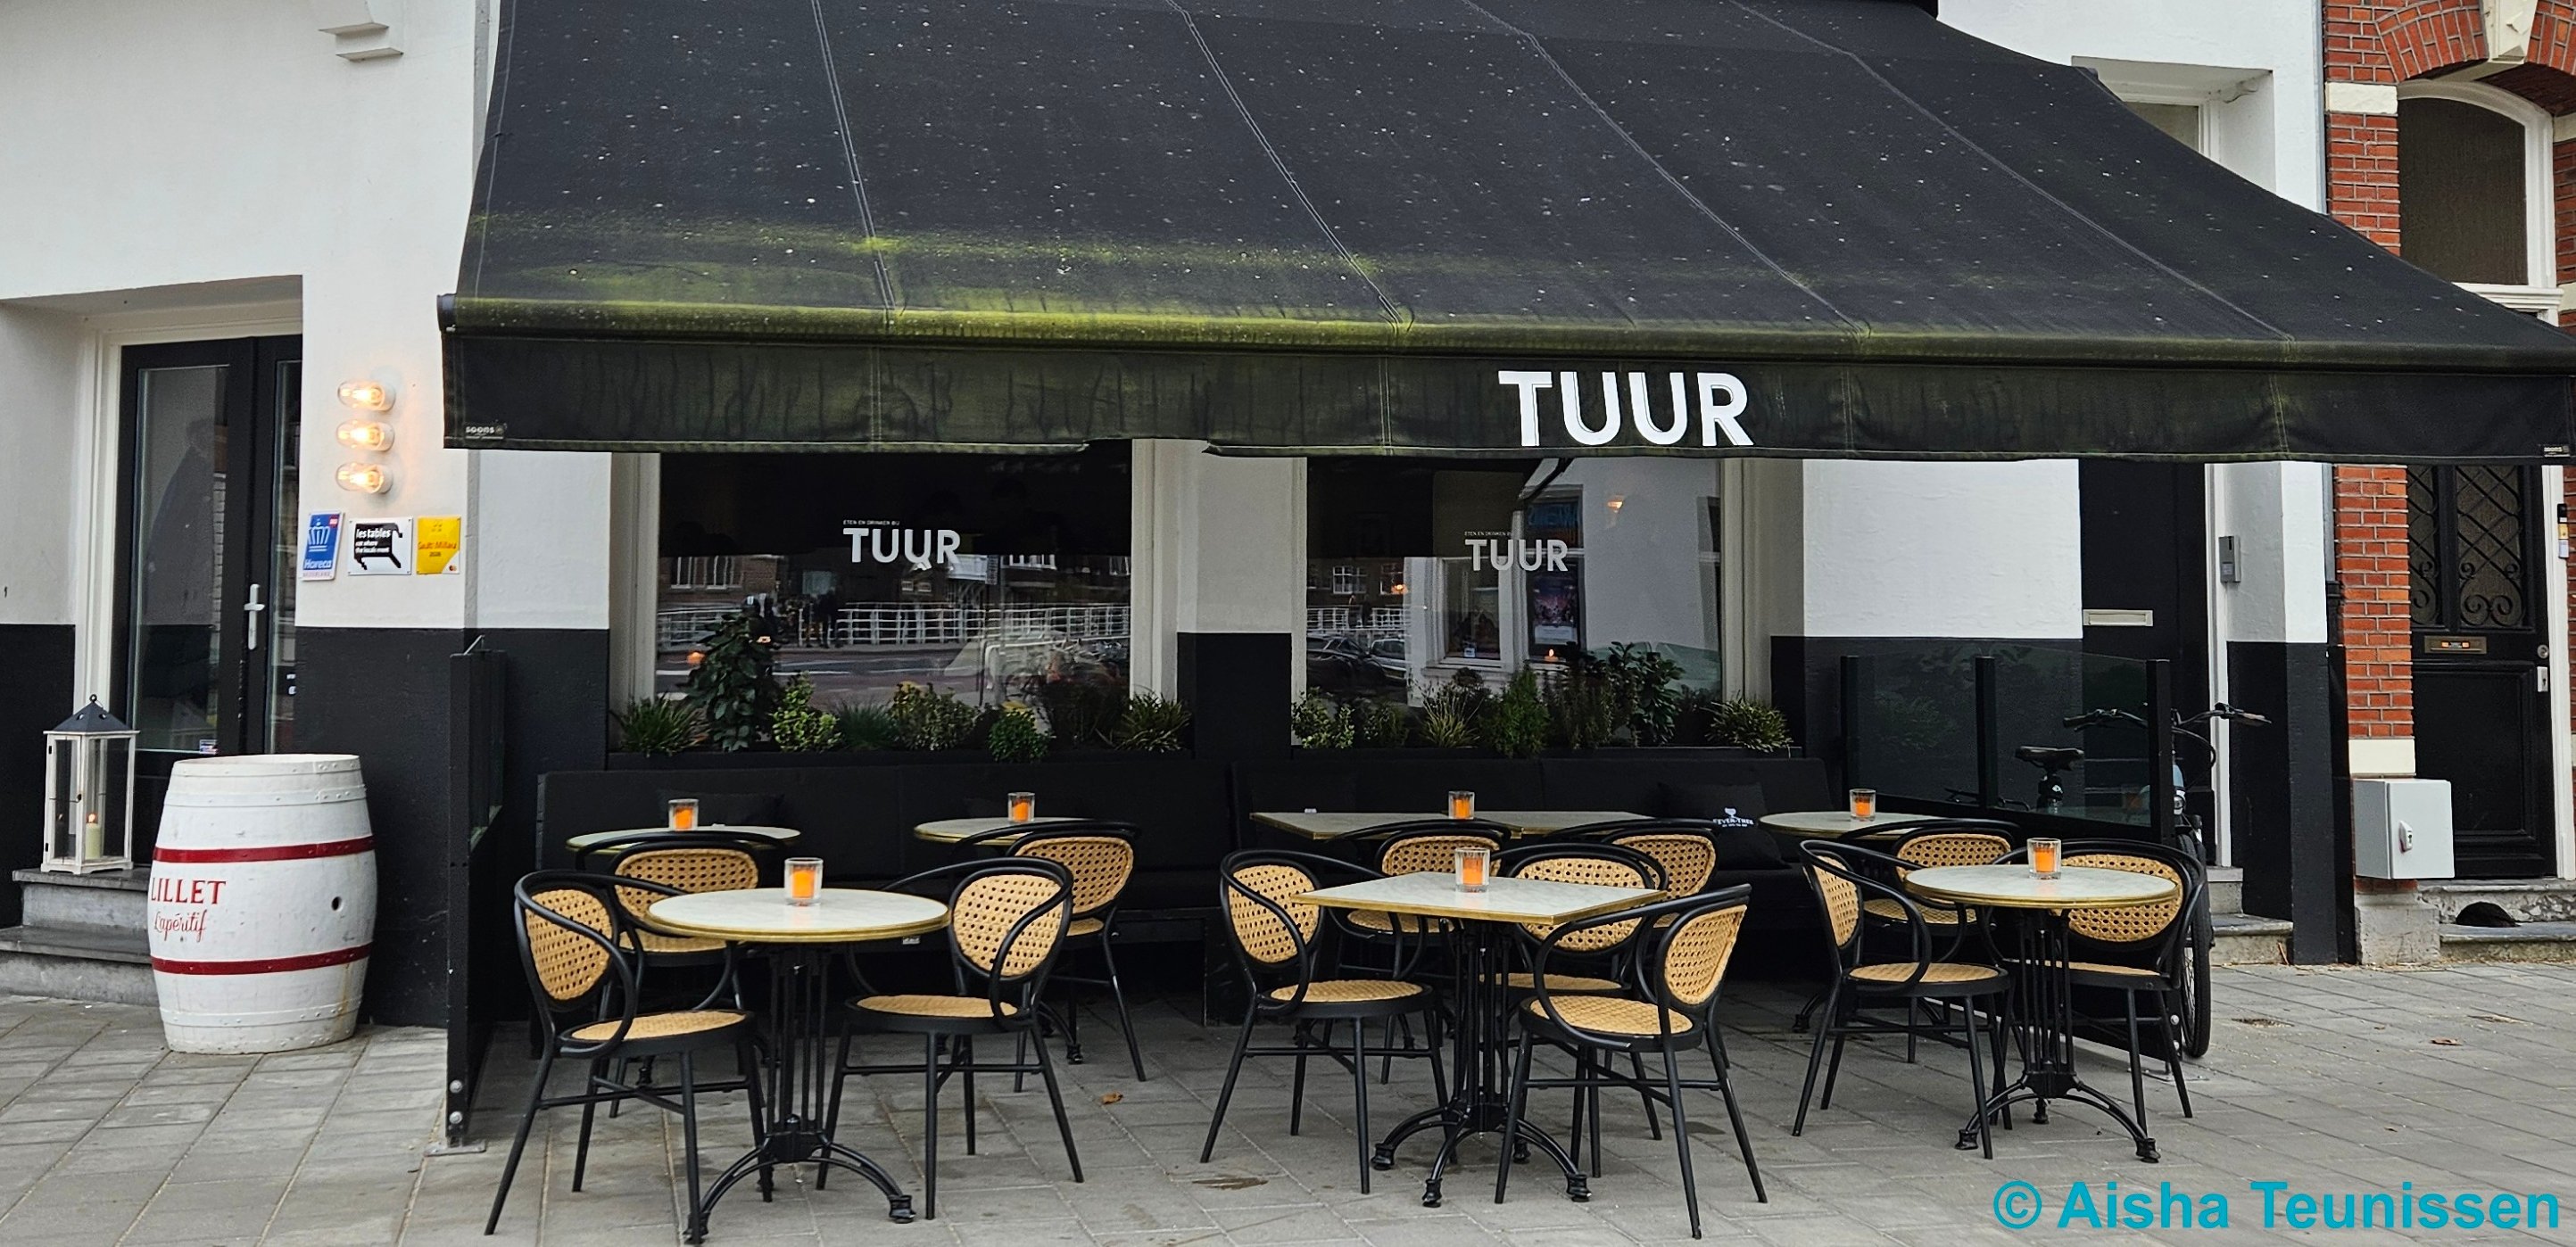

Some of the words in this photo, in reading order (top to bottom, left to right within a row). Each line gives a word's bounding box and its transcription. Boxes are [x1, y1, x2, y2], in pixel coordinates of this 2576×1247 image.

[1499, 371, 1753, 446] TUUR
[368, 527, 391, 538] tables
[843, 528, 960, 564] TUUR
[303, 558, 332, 569] Horeca
[1464, 539, 1569, 572] TUUR
[151, 878, 227, 904] LILLET
